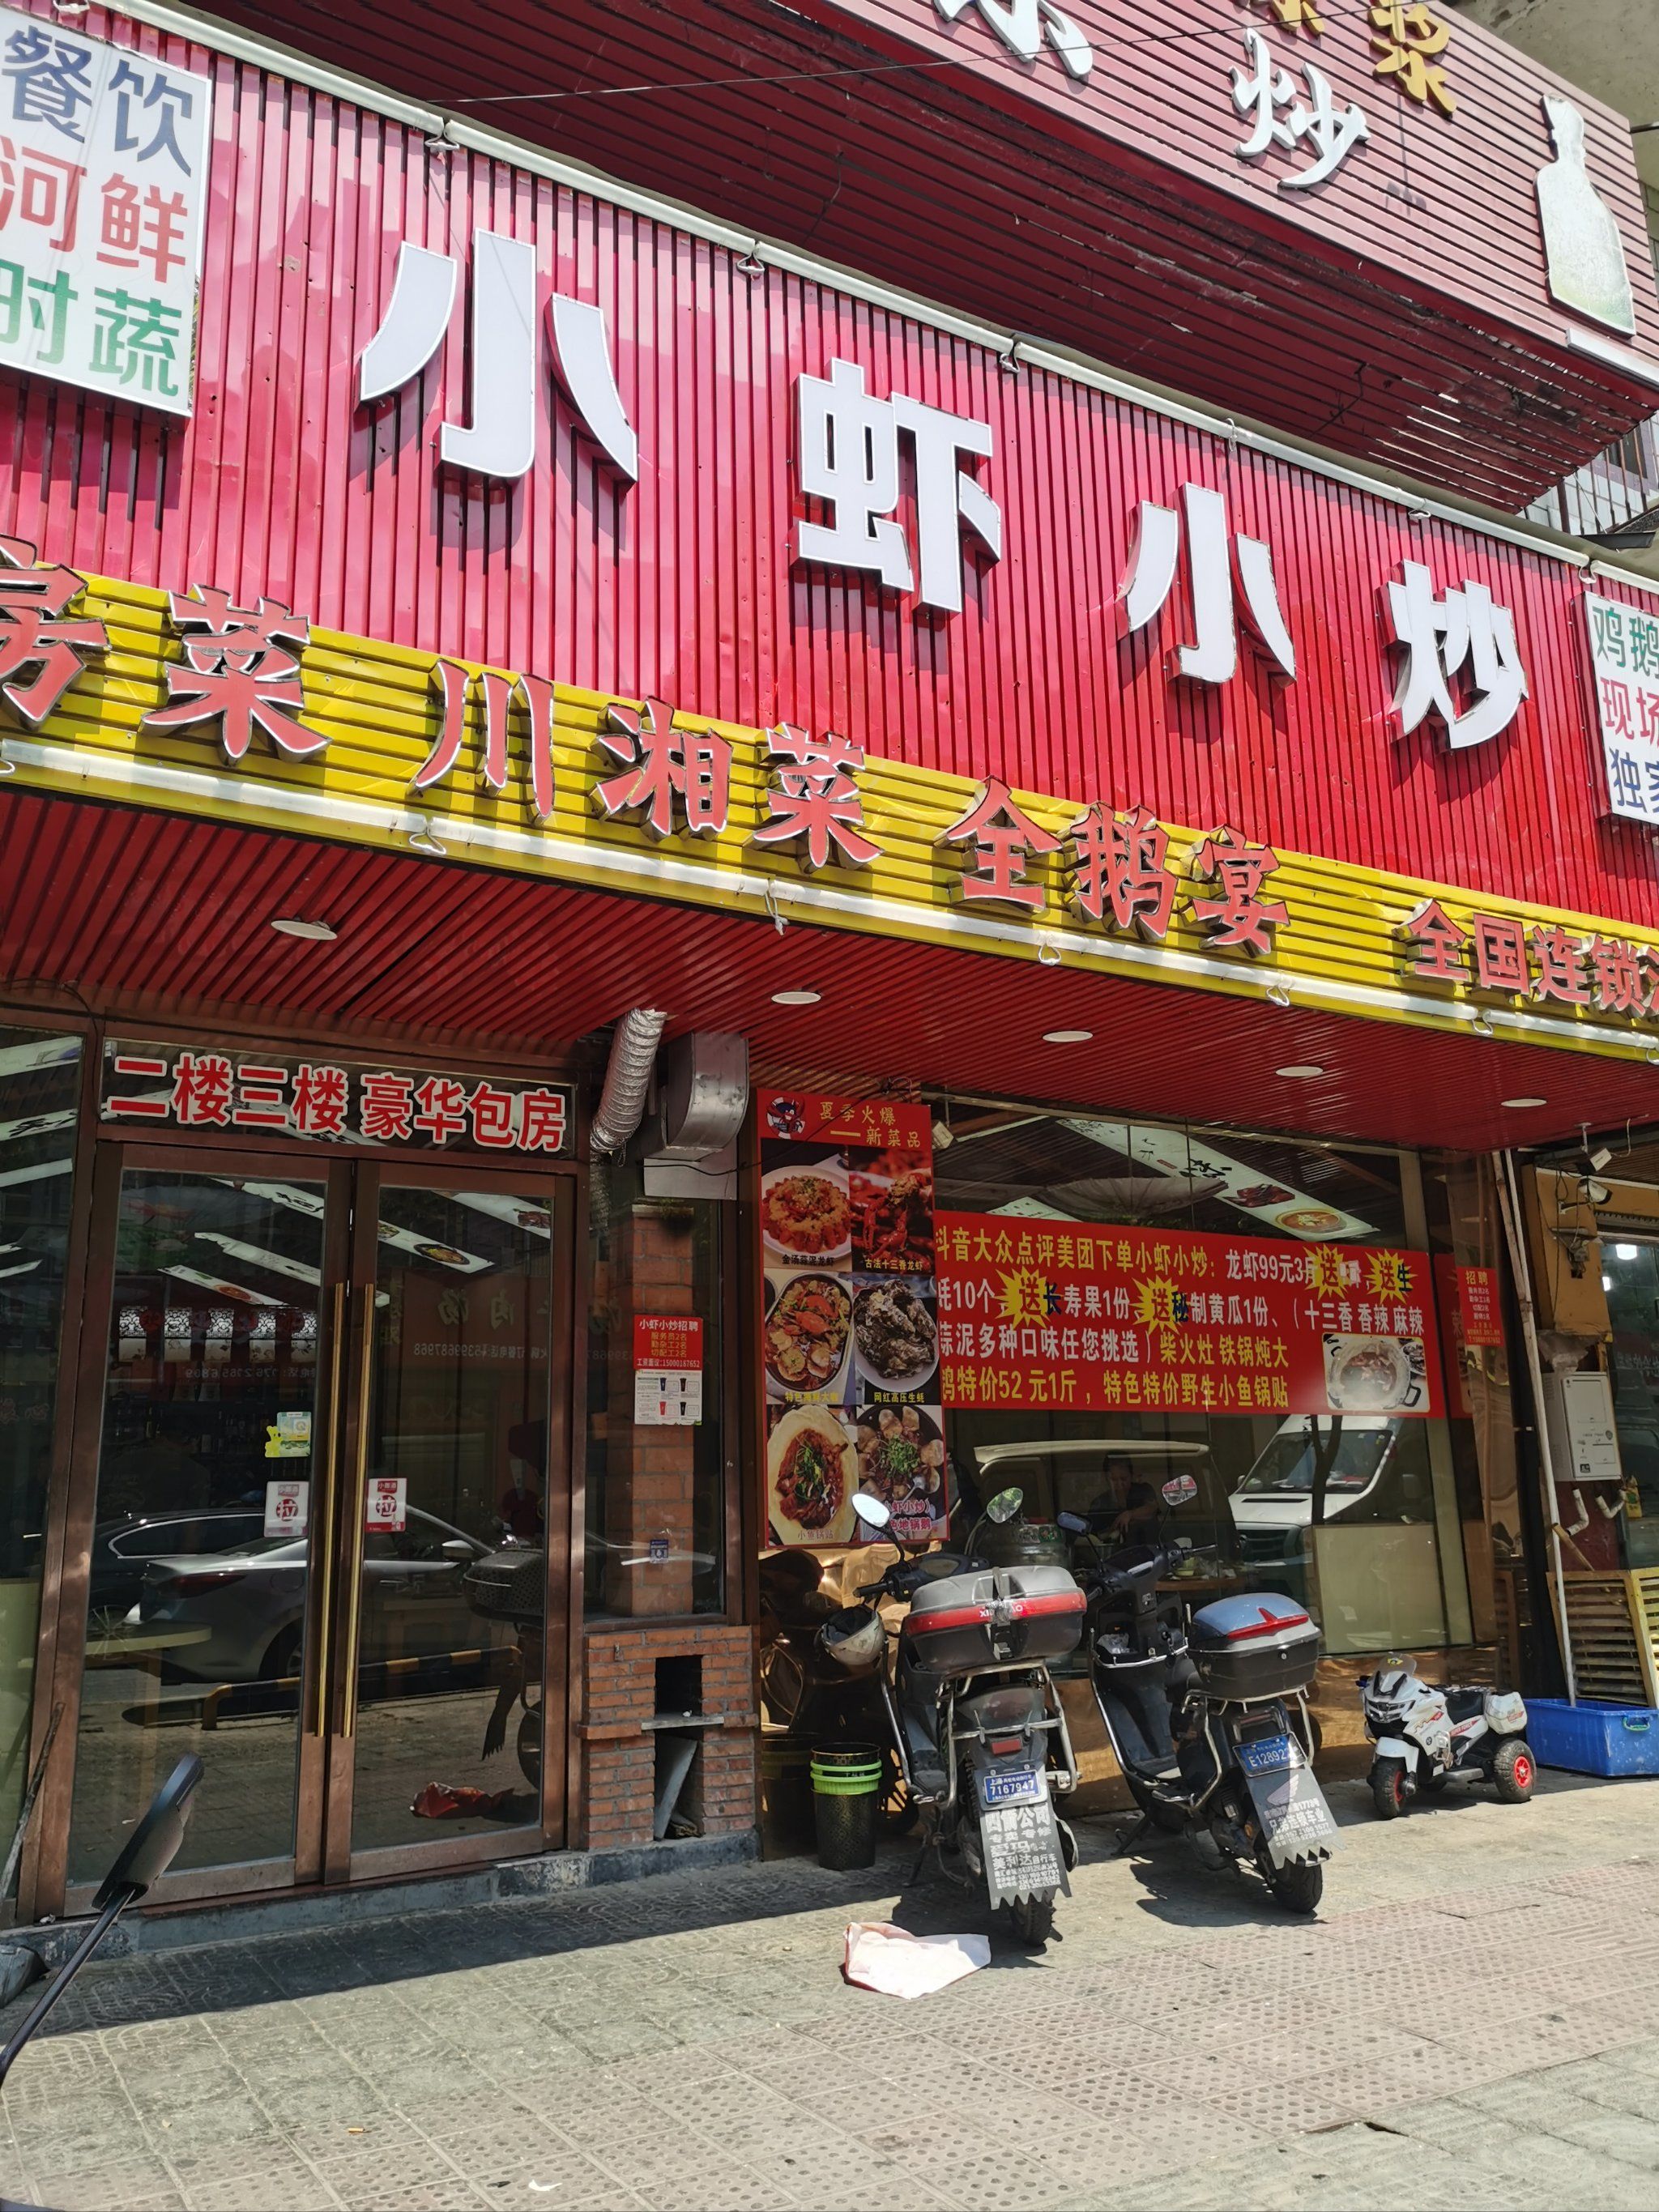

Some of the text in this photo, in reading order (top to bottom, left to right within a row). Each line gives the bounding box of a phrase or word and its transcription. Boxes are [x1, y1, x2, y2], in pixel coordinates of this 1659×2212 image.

[2, 24, 193, 177] 餐饮
[0, 134, 188, 283] 河鲜
[0, 258, 182, 397] 时蔬
[356, 227, 1529, 751] 小虾小炒
[407, 658, 885, 872] 川湘菜
[936, 775, 1290, 957] 全鹅宴
[820, 1101, 897, 1127] 夏季火爆
[864, 1257, 923, 1272] 古法十三香龙虾
[1465, 1269, 1489, 1286] 招聘
[638, 1319, 698, 1332] 小虾小炒招聘
[873, 1392, 926, 1404] 网红高压生蚝
[1248, 1747, 1291, 1767] E12892
[990, 1780, 1034, 1796] 7167947
